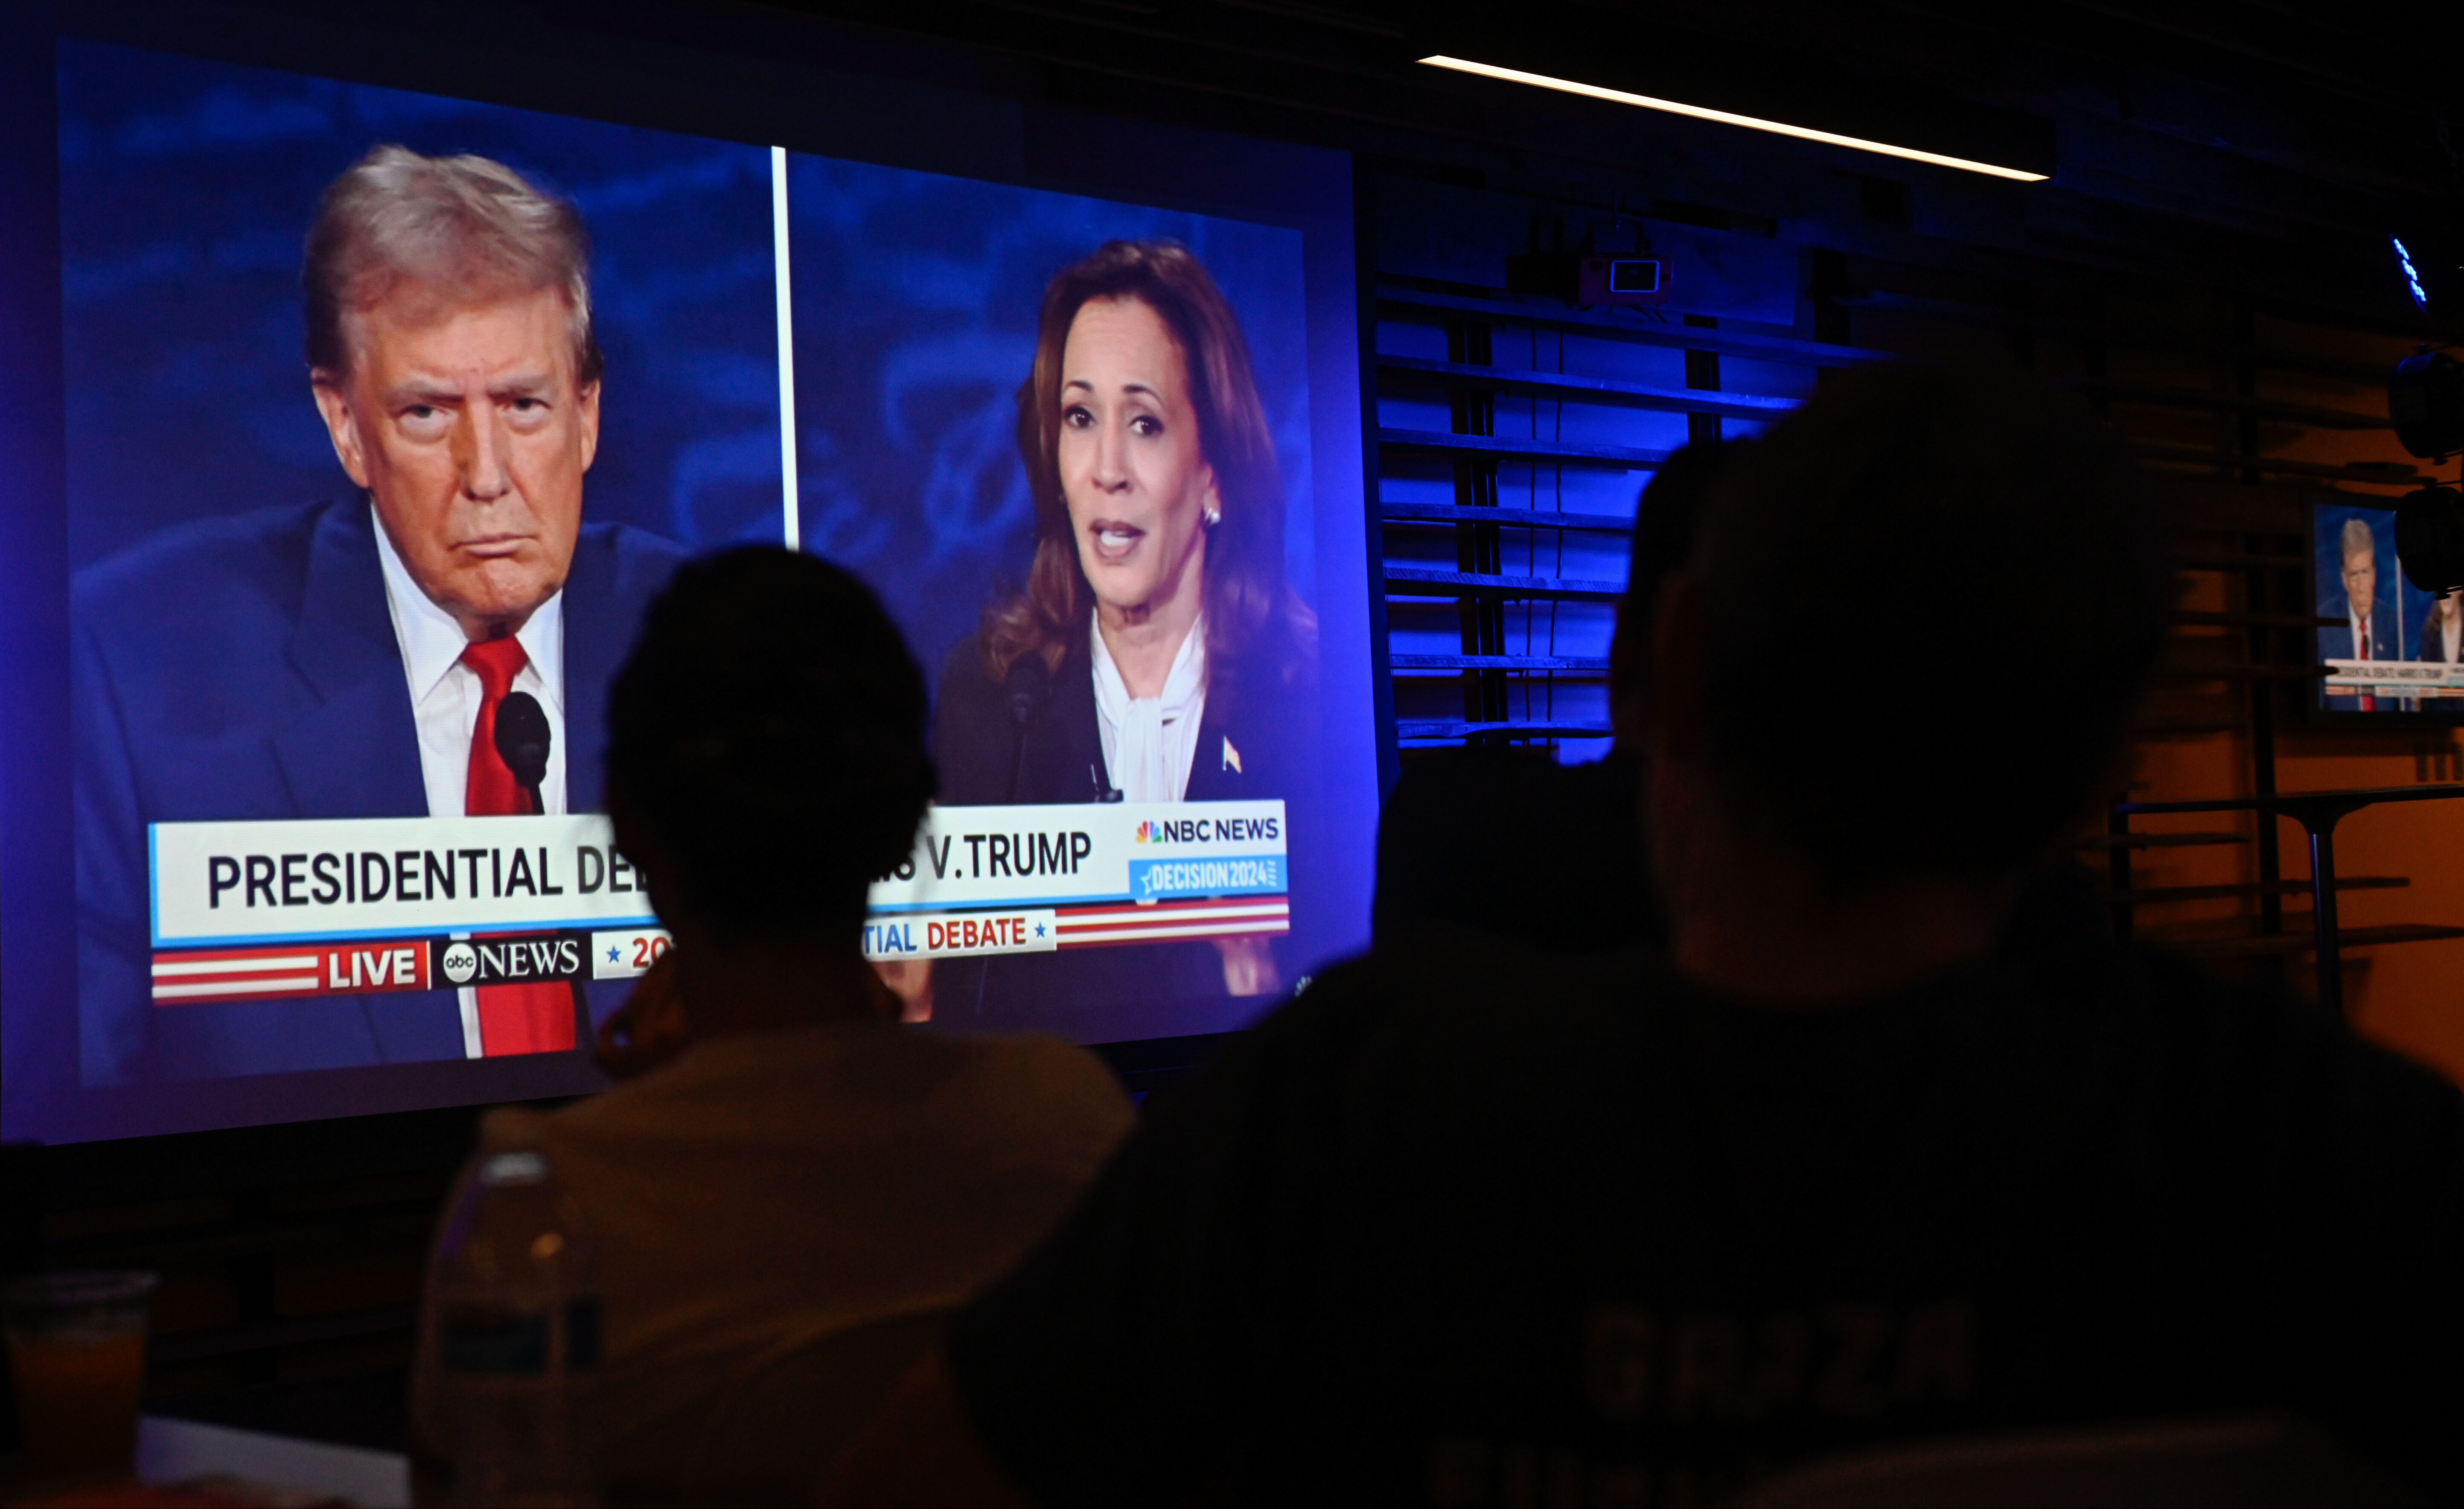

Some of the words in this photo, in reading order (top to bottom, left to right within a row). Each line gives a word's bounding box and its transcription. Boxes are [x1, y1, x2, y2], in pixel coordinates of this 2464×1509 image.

[1164, 819, 1211, 843] NBC
[1216, 817, 1279, 841] NEWS
[209, 847, 563, 909] PRESIDENTIAL
[927, 917, 1026, 950] DEBATE
[329, 948, 415, 989] LIVE
[446, 954, 474, 969] abc
[478, 940, 580, 979] NEWS
